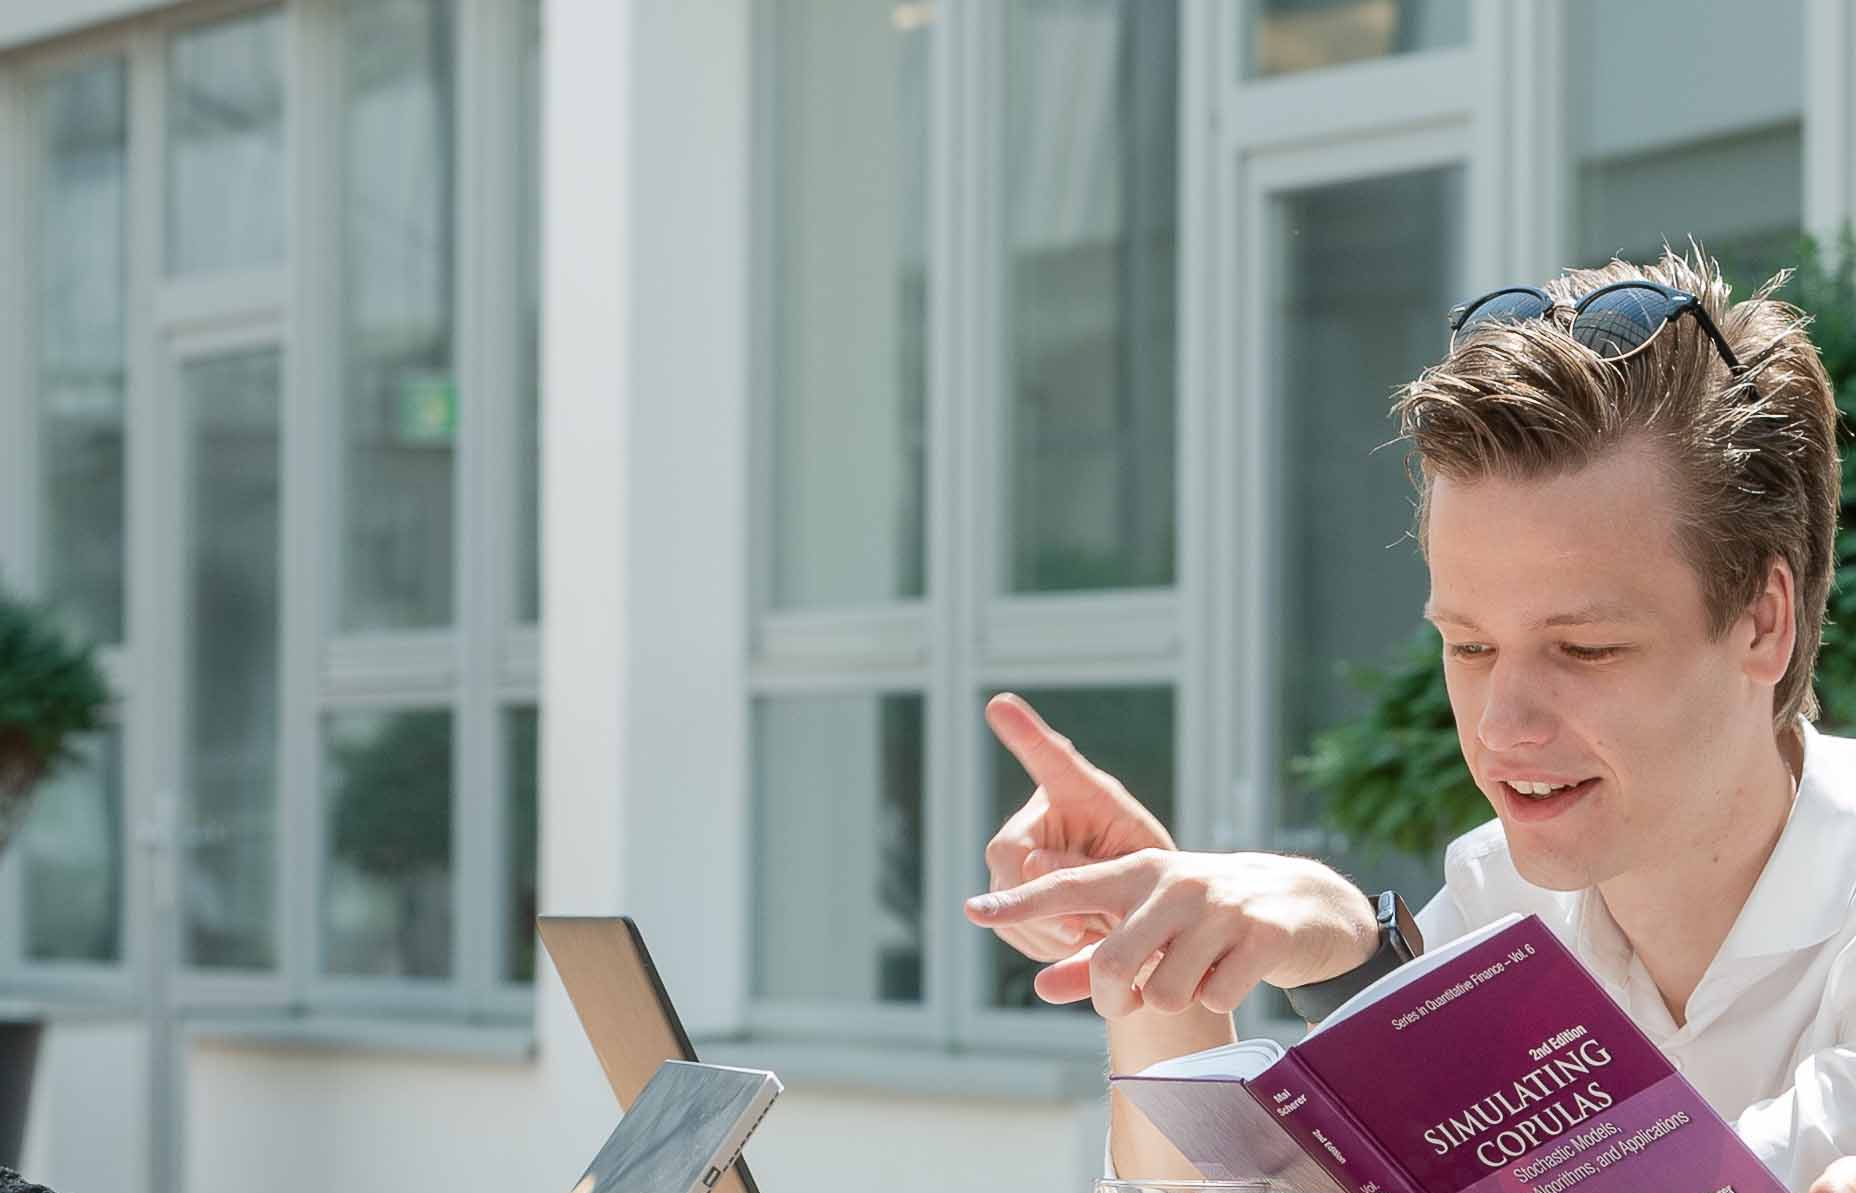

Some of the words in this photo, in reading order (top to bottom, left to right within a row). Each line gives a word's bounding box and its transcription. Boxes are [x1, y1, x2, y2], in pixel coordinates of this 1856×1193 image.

[1392, 1010, 1420, 1031] Series
[1417, 1006, 1428, 1018] in
[1425, 980, 1475, 1012] Quantitative
[1471, 961, 1505, 985] Finance
[1507, 949, 1529, 964] Vol.
[1525, 943, 1537, 956] 6
[1528, 1039, 1552, 1062] 2nd
[1549, 1024, 1588, 1051] Edition
[1276, 1093, 1307, 1117] Scherer
[1423, 1039, 1613, 1156] SIMULATING
[1476, 1081, 1613, 1168] COPULAS
[1323, 1139, 1347, 1165] Edition
[1513, 1143, 1576, 1184] Stochastic
[1570, 1120, 1622, 1153] Models,
[1598, 1144, 1623, 1169] and
[1620, 1109, 1690, 1156] Applications
